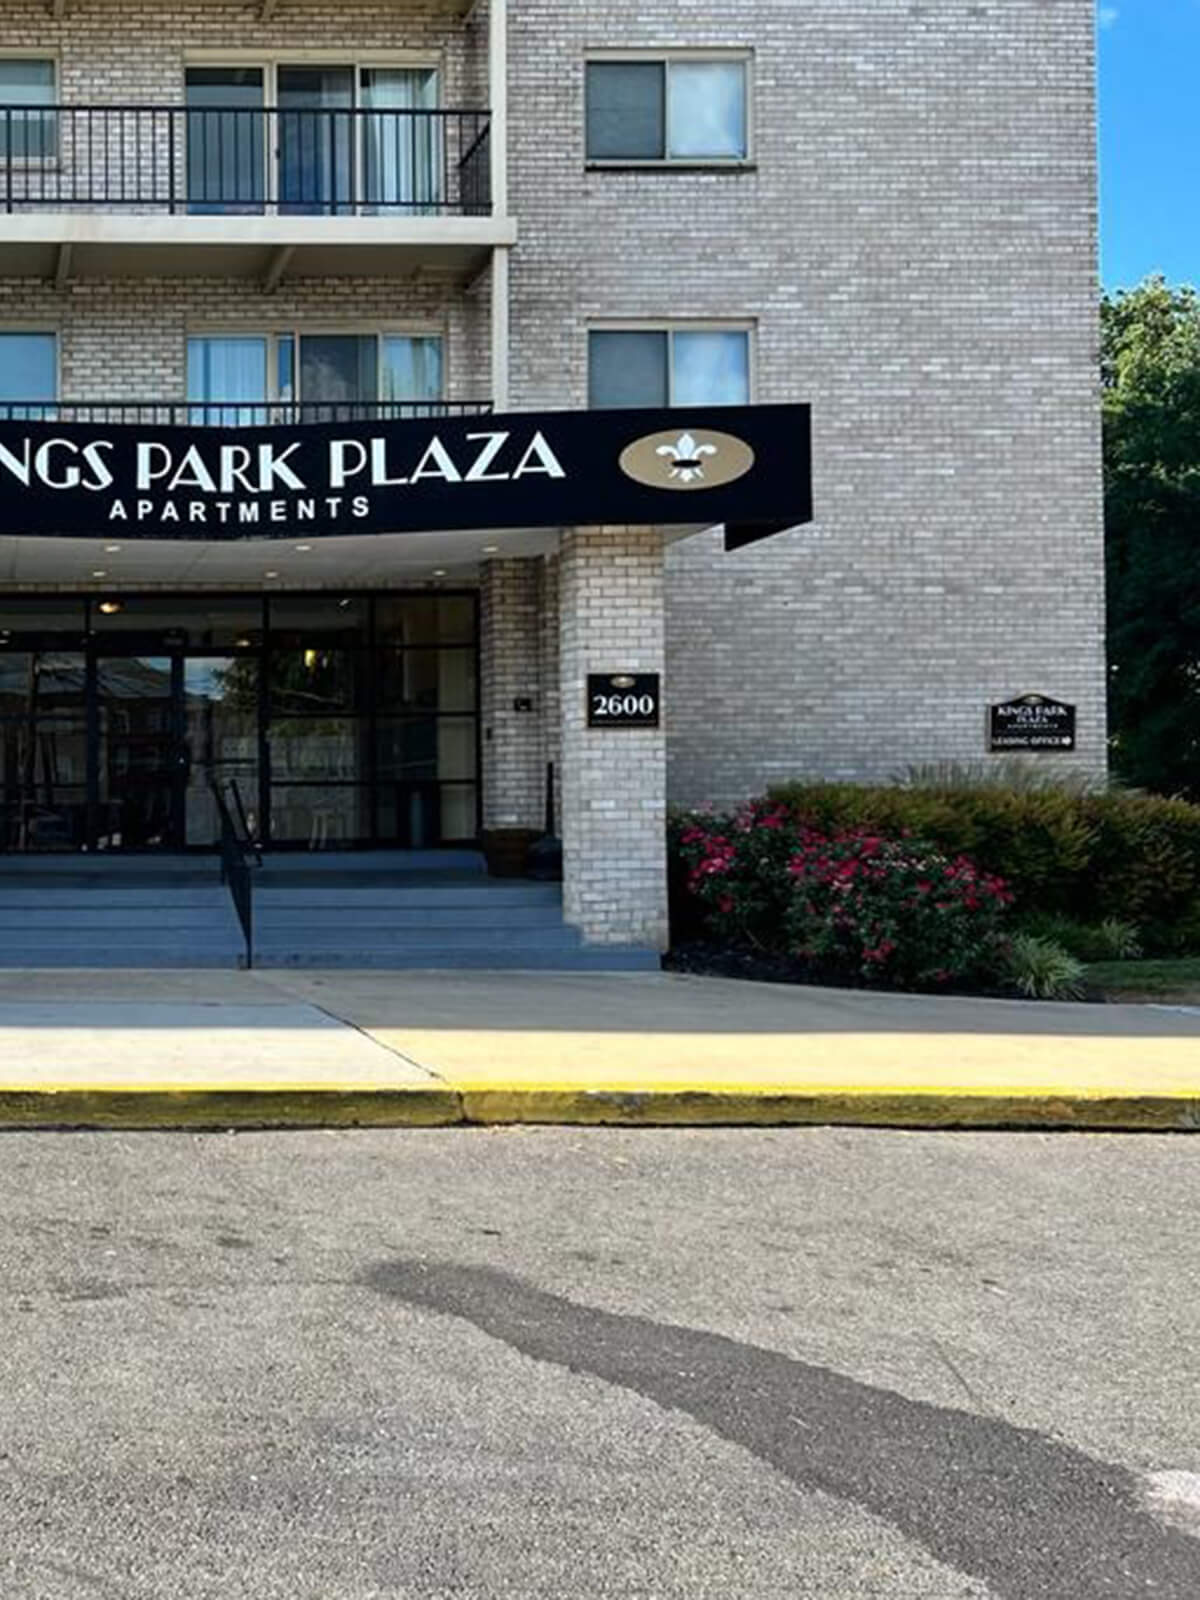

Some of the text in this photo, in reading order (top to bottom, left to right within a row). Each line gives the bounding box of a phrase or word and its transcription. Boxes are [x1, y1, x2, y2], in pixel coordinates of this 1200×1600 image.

[136, 442, 307, 493] PARK
[329, 431, 567, 489] PLAZA
[109, 496, 369, 523] APARTMENTS
[593, 694, 654, 715] 2600
